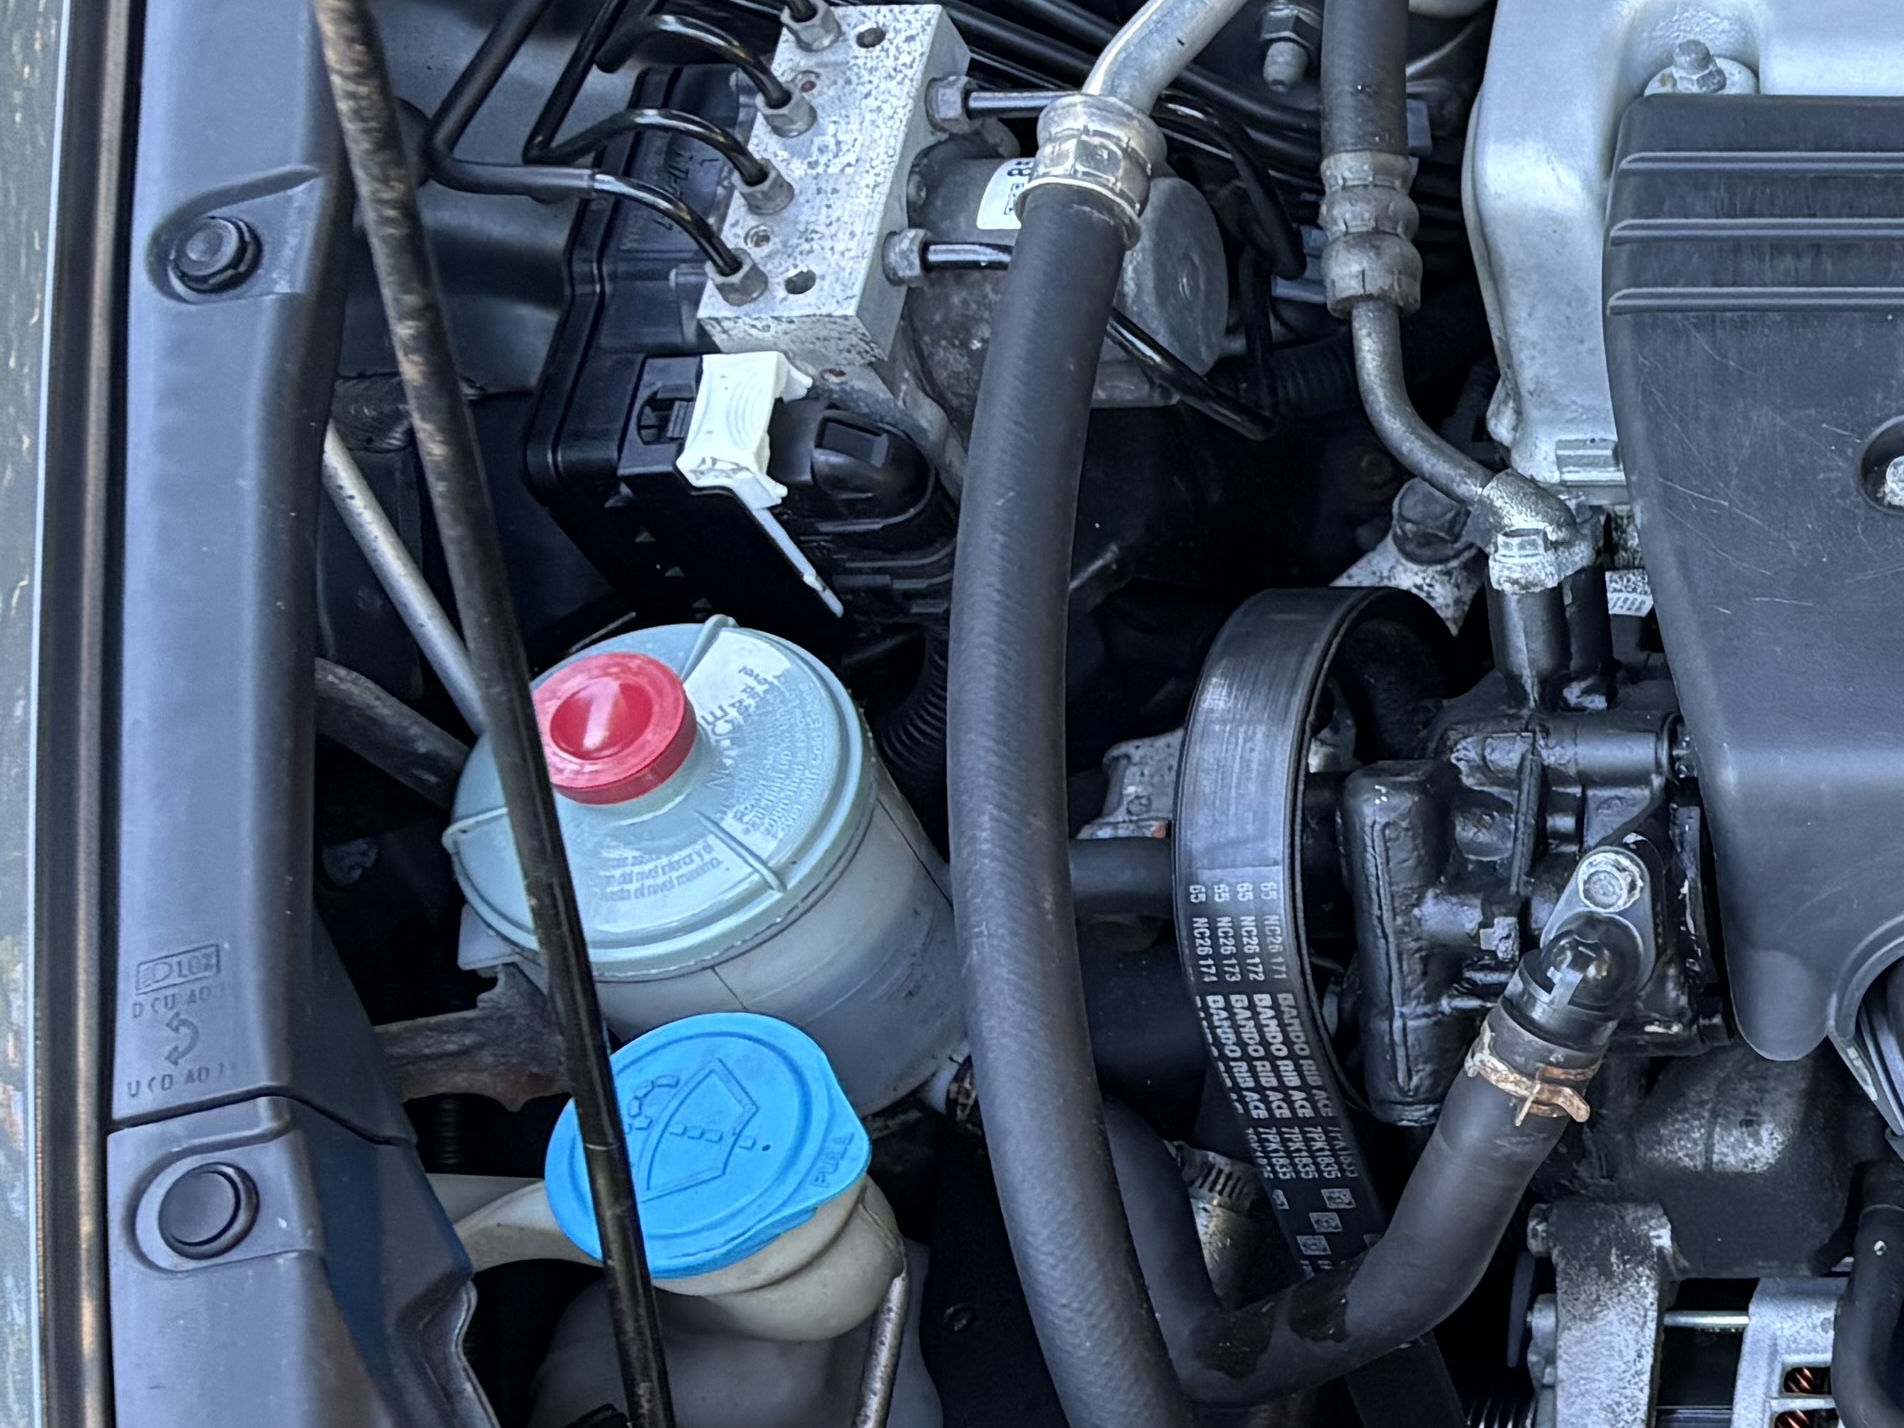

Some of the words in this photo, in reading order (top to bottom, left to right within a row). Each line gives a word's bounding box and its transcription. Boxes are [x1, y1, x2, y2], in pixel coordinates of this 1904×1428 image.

[1186, 882, 1206, 904] 65
[1210, 882, 1230, 903] 65
[1233, 881, 1254, 903] 65
[1257, 880, 1278, 901] 65
[1189, 915, 1214, 956] NC26
[1212, 915, 1238, 956] NC26
[1236, 913, 1262, 954] NC26
[1260, 912, 1286, 953] NC26
[1197, 957, 1218, 983] 174
[1220, 956, 1241, 983] 173
[1244, 956, 1265, 983] 172
[1268, 954, 1289, 981] 171
[1204, 991, 1240, 1061] BANDO
[1228, 990, 1263, 1060] BANDO
[1251, 990, 1286, 1059] BANDO
[1276, 990, 1310, 1057] BANDO
[1243, 1088, 1268, 1121] ACE
[1266, 1087, 1290, 1121] ACE
[1289, 1087, 1314, 1120] ACE
[1311, 1087, 1335, 1119] ACE
[809, 1133, 854, 1186] PULL
